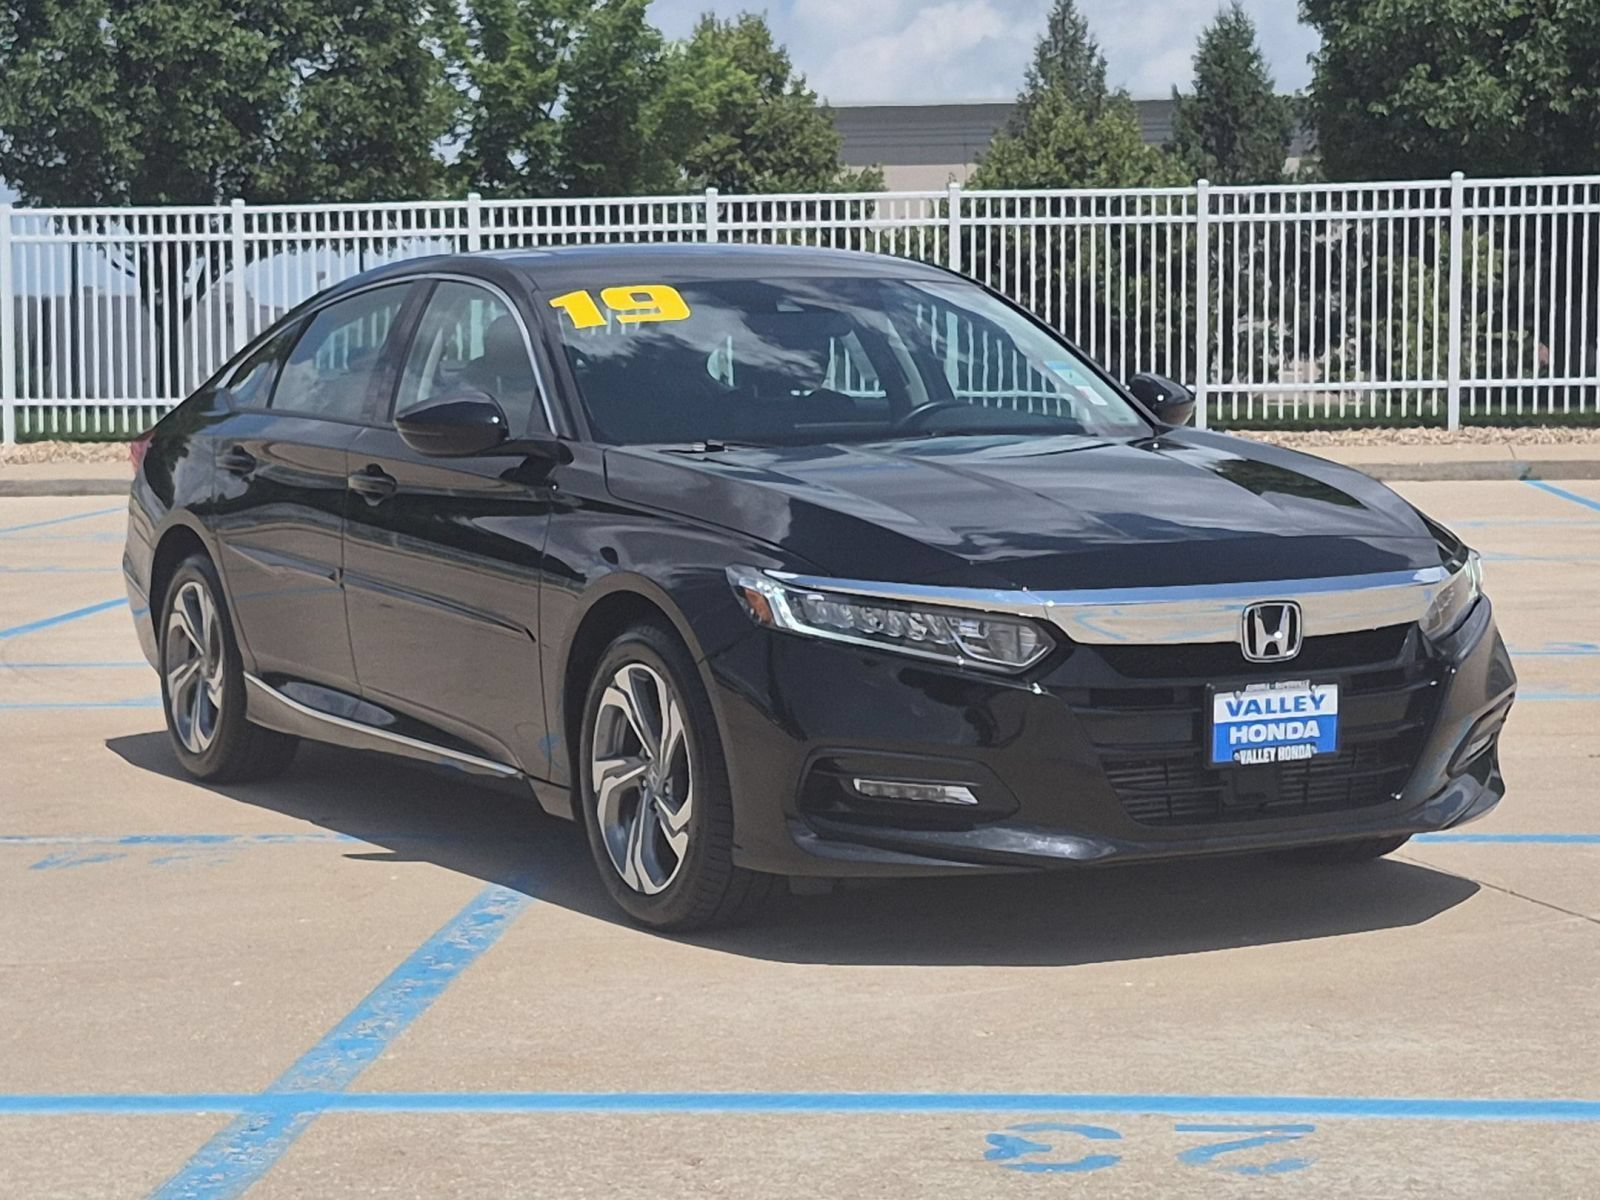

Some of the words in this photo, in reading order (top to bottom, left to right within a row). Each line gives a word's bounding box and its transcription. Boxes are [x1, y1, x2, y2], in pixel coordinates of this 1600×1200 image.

[549, 284, 690, 329] 19
[1253, 604, 1292, 657] H
[1225, 694, 1326, 717] VALLEY
[1229, 720, 1320, 744] HONDA
[1240, 746, 1276, 765] VALLEY
[1278, 744, 1312, 761] HONDA
